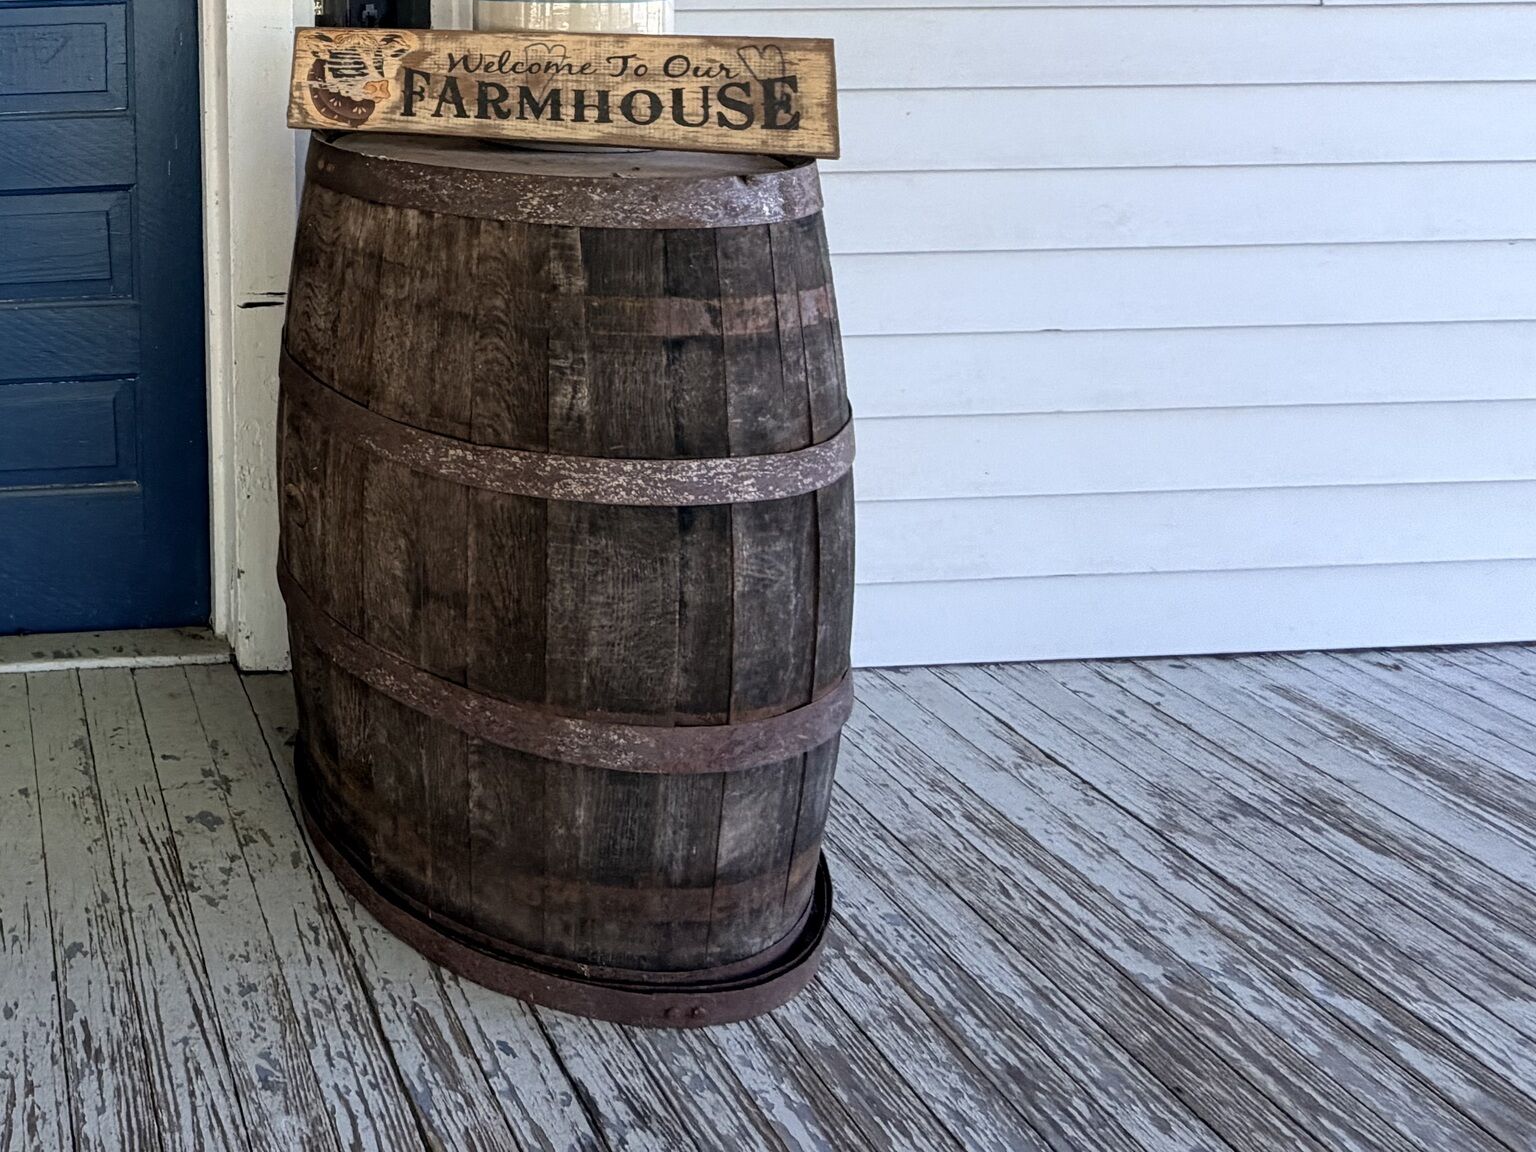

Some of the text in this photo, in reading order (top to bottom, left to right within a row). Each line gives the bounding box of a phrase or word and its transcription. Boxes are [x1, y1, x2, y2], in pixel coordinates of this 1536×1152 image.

[448, 44, 741, 81] Welcome To Our
[400, 68, 800, 130] FARMHOUSE
